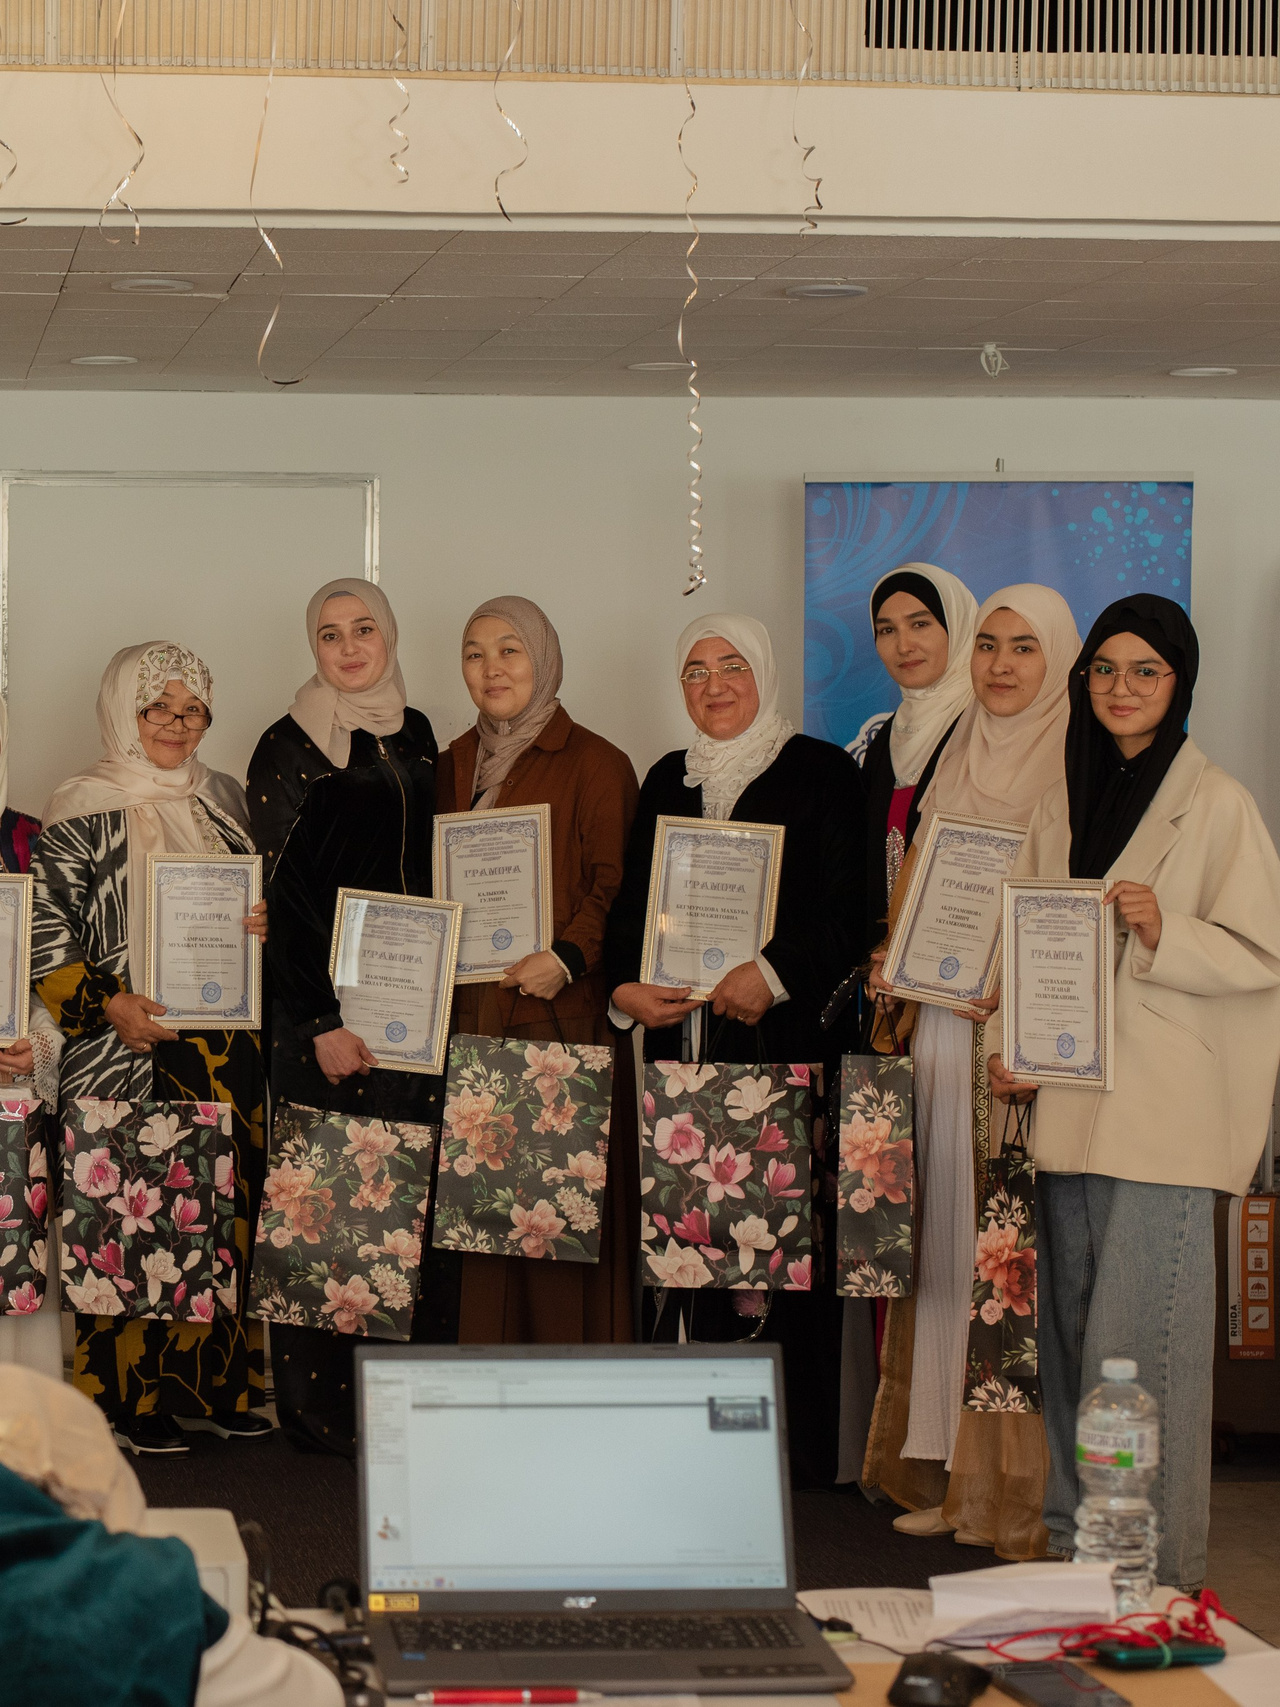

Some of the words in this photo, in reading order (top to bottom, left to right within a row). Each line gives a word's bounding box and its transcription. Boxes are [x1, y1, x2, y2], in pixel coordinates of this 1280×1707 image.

[463, 864, 521, 878] ГРАМОТА
[682, 879, 746, 893] ГРАМОТА
[939, 877, 996, 896] ГРАМОТА
[173, 912, 232, 921] ГРАМОТА
[360, 948, 424, 965] ГРАМОТА
[1029, 949, 1084, 961] ГРАМОТА
